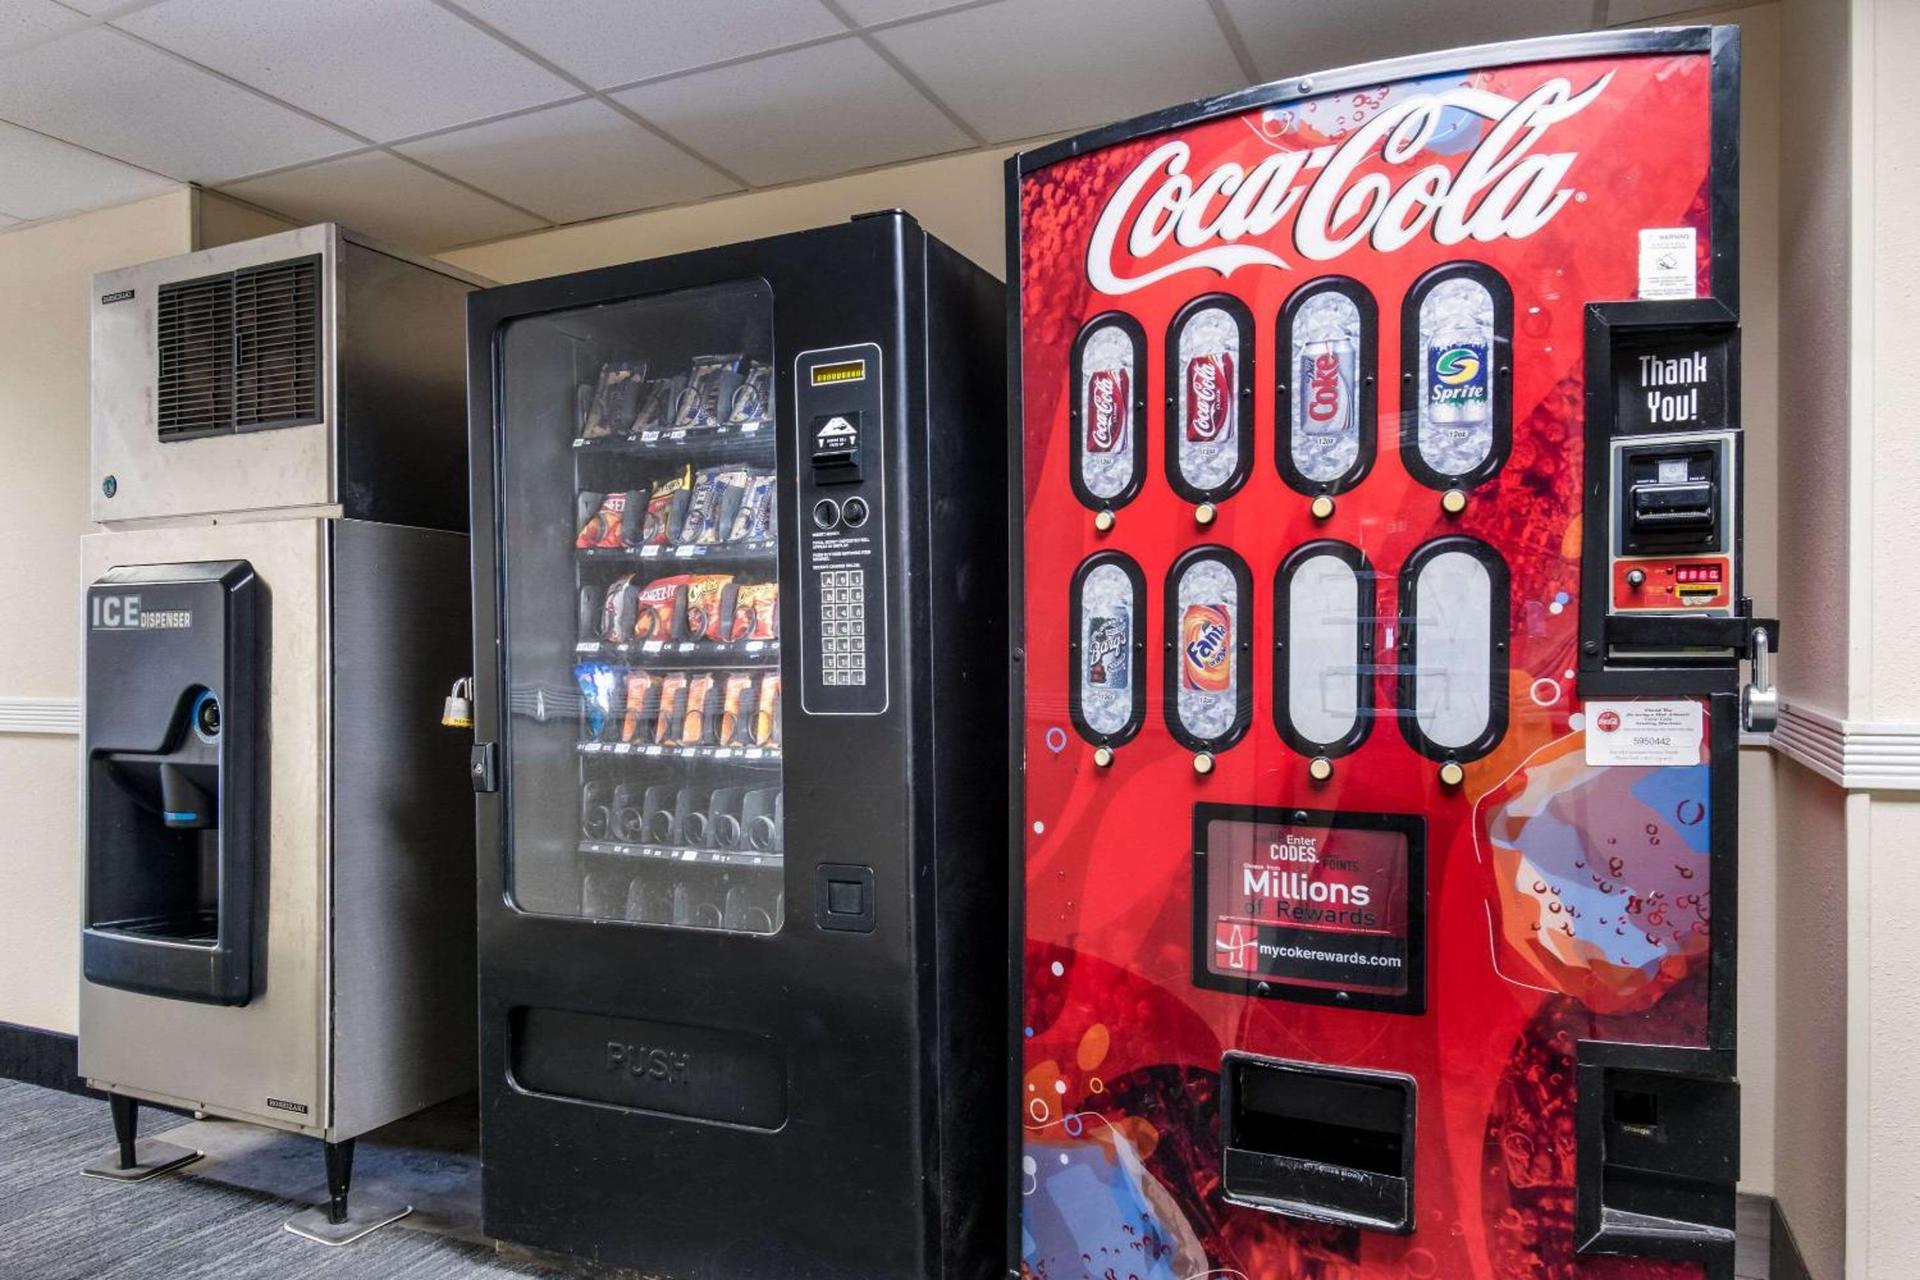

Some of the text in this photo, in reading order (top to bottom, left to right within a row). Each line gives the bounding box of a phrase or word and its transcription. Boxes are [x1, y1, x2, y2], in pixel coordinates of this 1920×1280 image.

[1087, 70, 1616, 295] Coca-Cola
[1639, 351, 1708, 387] Thank
[1308, 352, 1340, 422] Coke
[1432, 383, 1484, 402] Sprite
[1647, 388, 1698, 424] You!
[92, 596, 140, 627] ICE
[140, 611, 190, 628] DISPENSER
[1270, 844, 1320, 863] CODES.
[1286, 834, 1317, 846] Enter
[1243, 869, 1371, 906] Millions
[1277, 900, 1376, 926] Rewards
[1259, 940, 1402, 968] mycokerewards.com
[607, 1041, 690, 1084] PUSH
